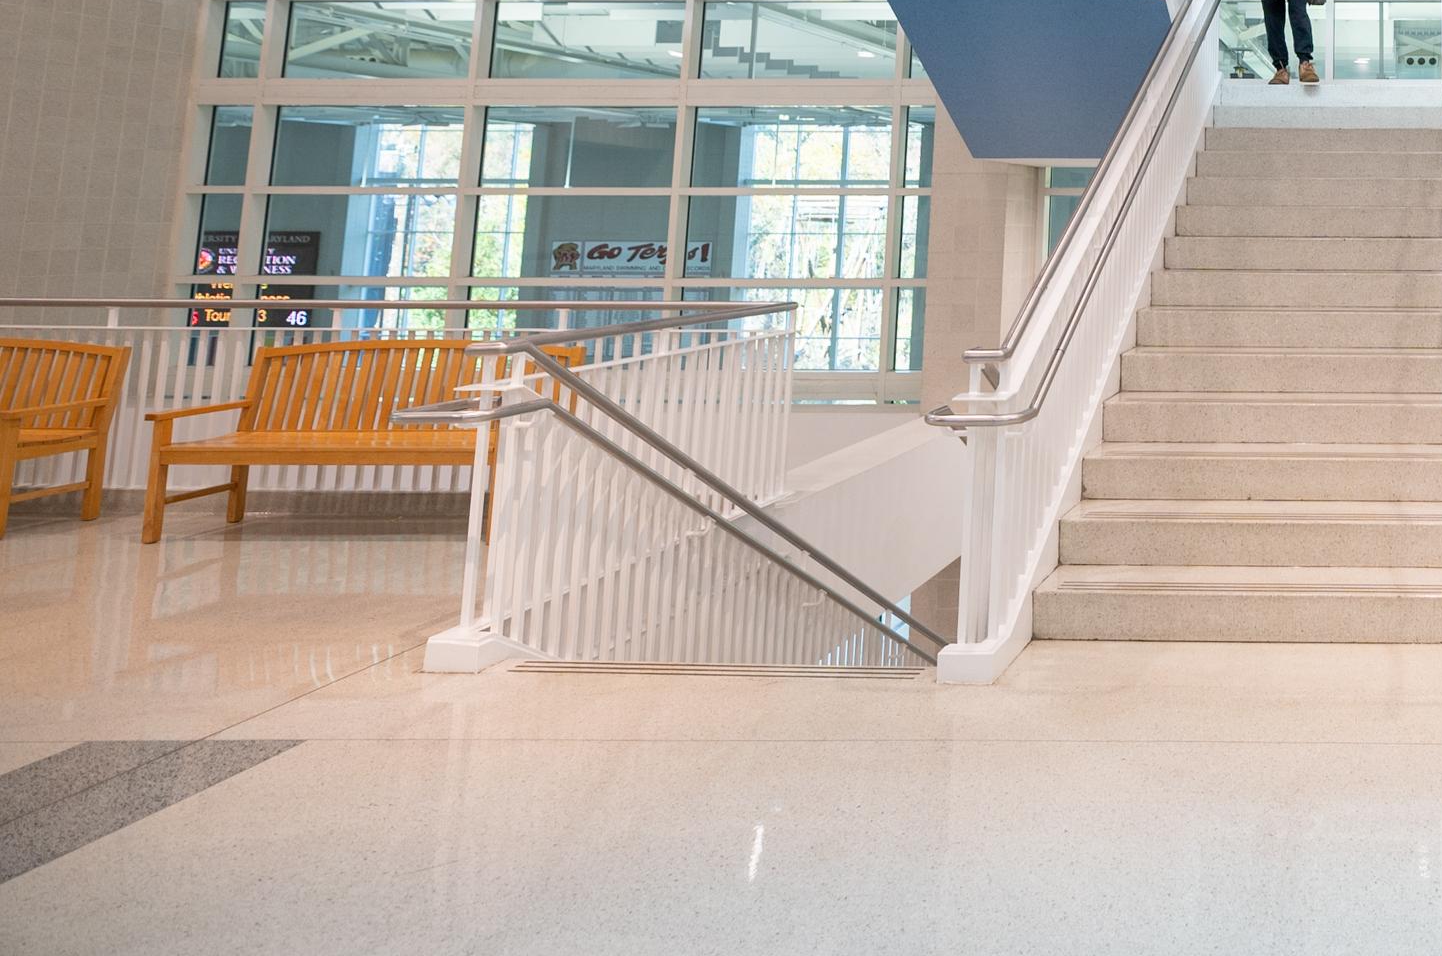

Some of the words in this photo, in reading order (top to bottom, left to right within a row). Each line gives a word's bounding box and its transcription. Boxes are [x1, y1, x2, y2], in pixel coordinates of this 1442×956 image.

[587, 243, 622, 260] Go
[218, 255, 297, 265] RECTION
[286, 310, 308, 326] 46
